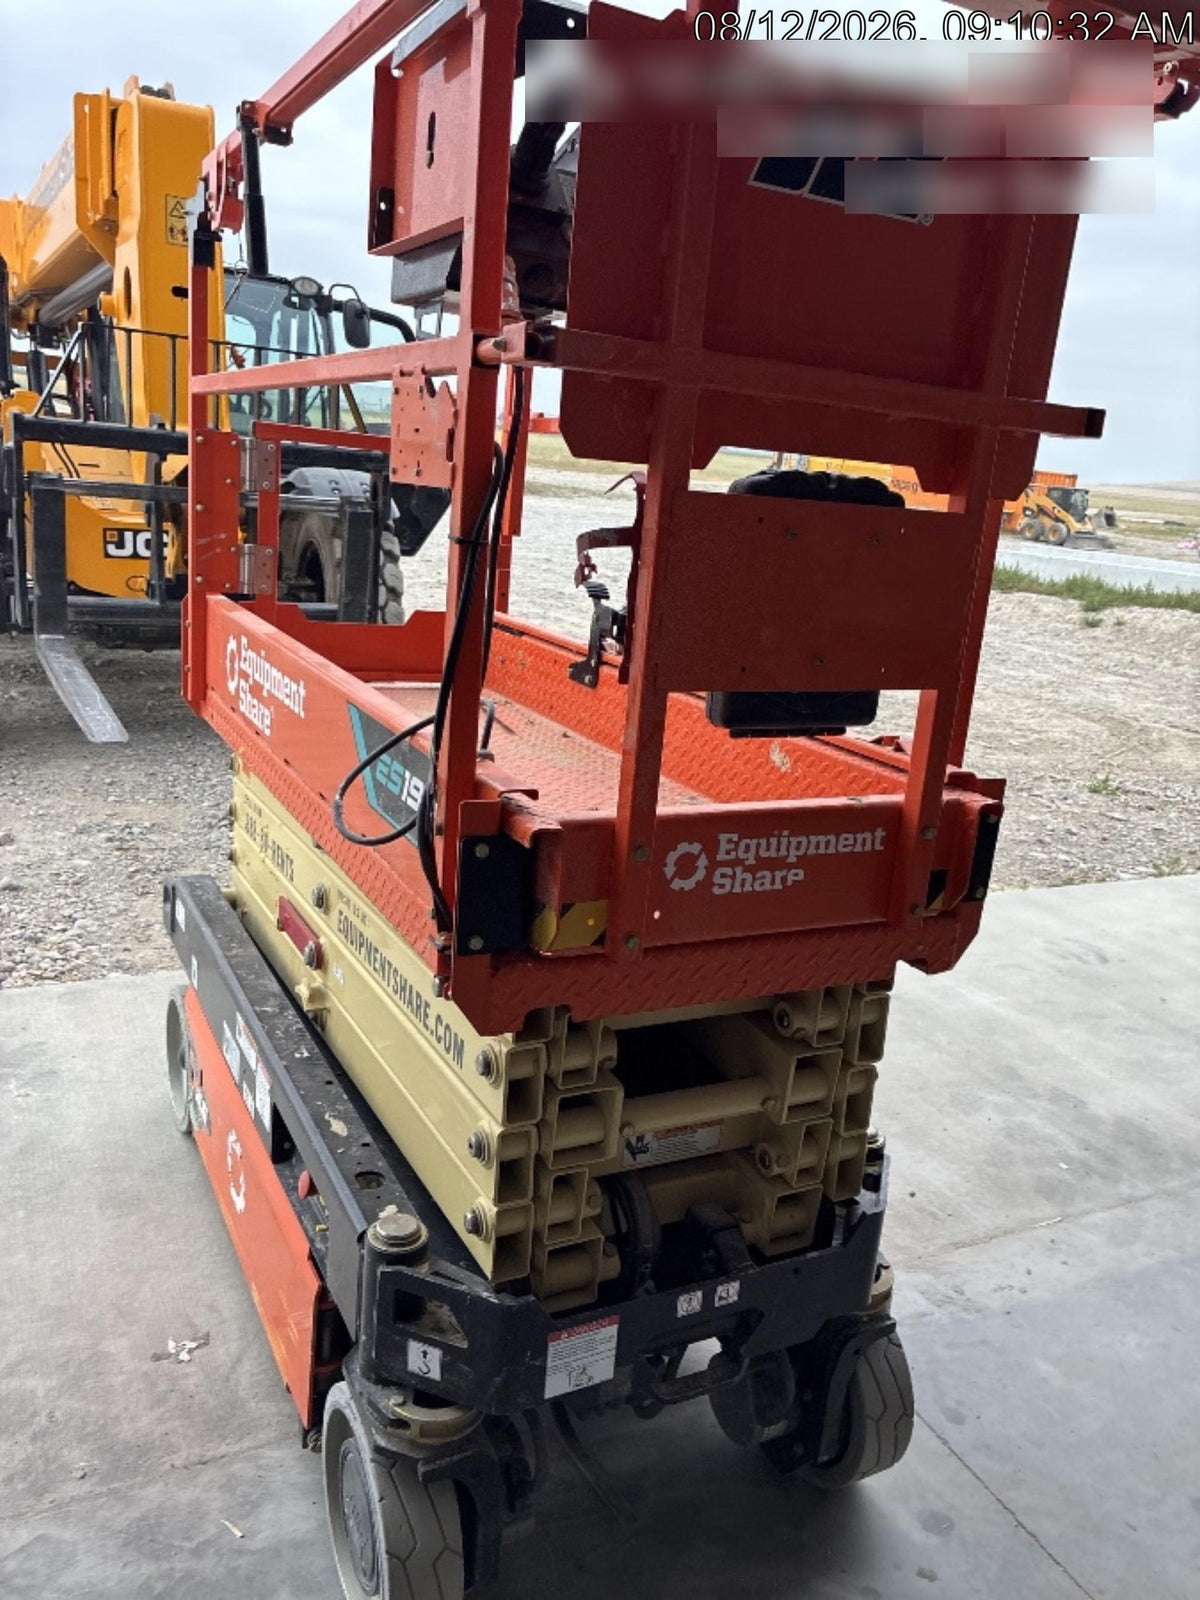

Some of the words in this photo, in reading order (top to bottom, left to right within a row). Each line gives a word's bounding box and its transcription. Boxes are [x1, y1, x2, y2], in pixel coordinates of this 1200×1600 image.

[106, 530, 168, 557] JC
[240, 635, 306, 719] Equipment
[239, 678, 272, 737] Share
[376, 753, 425, 811] ES19
[716, 827, 887, 865] Equipment
[337, 909, 465, 1070] EQUIPMENTSHARE.COM
